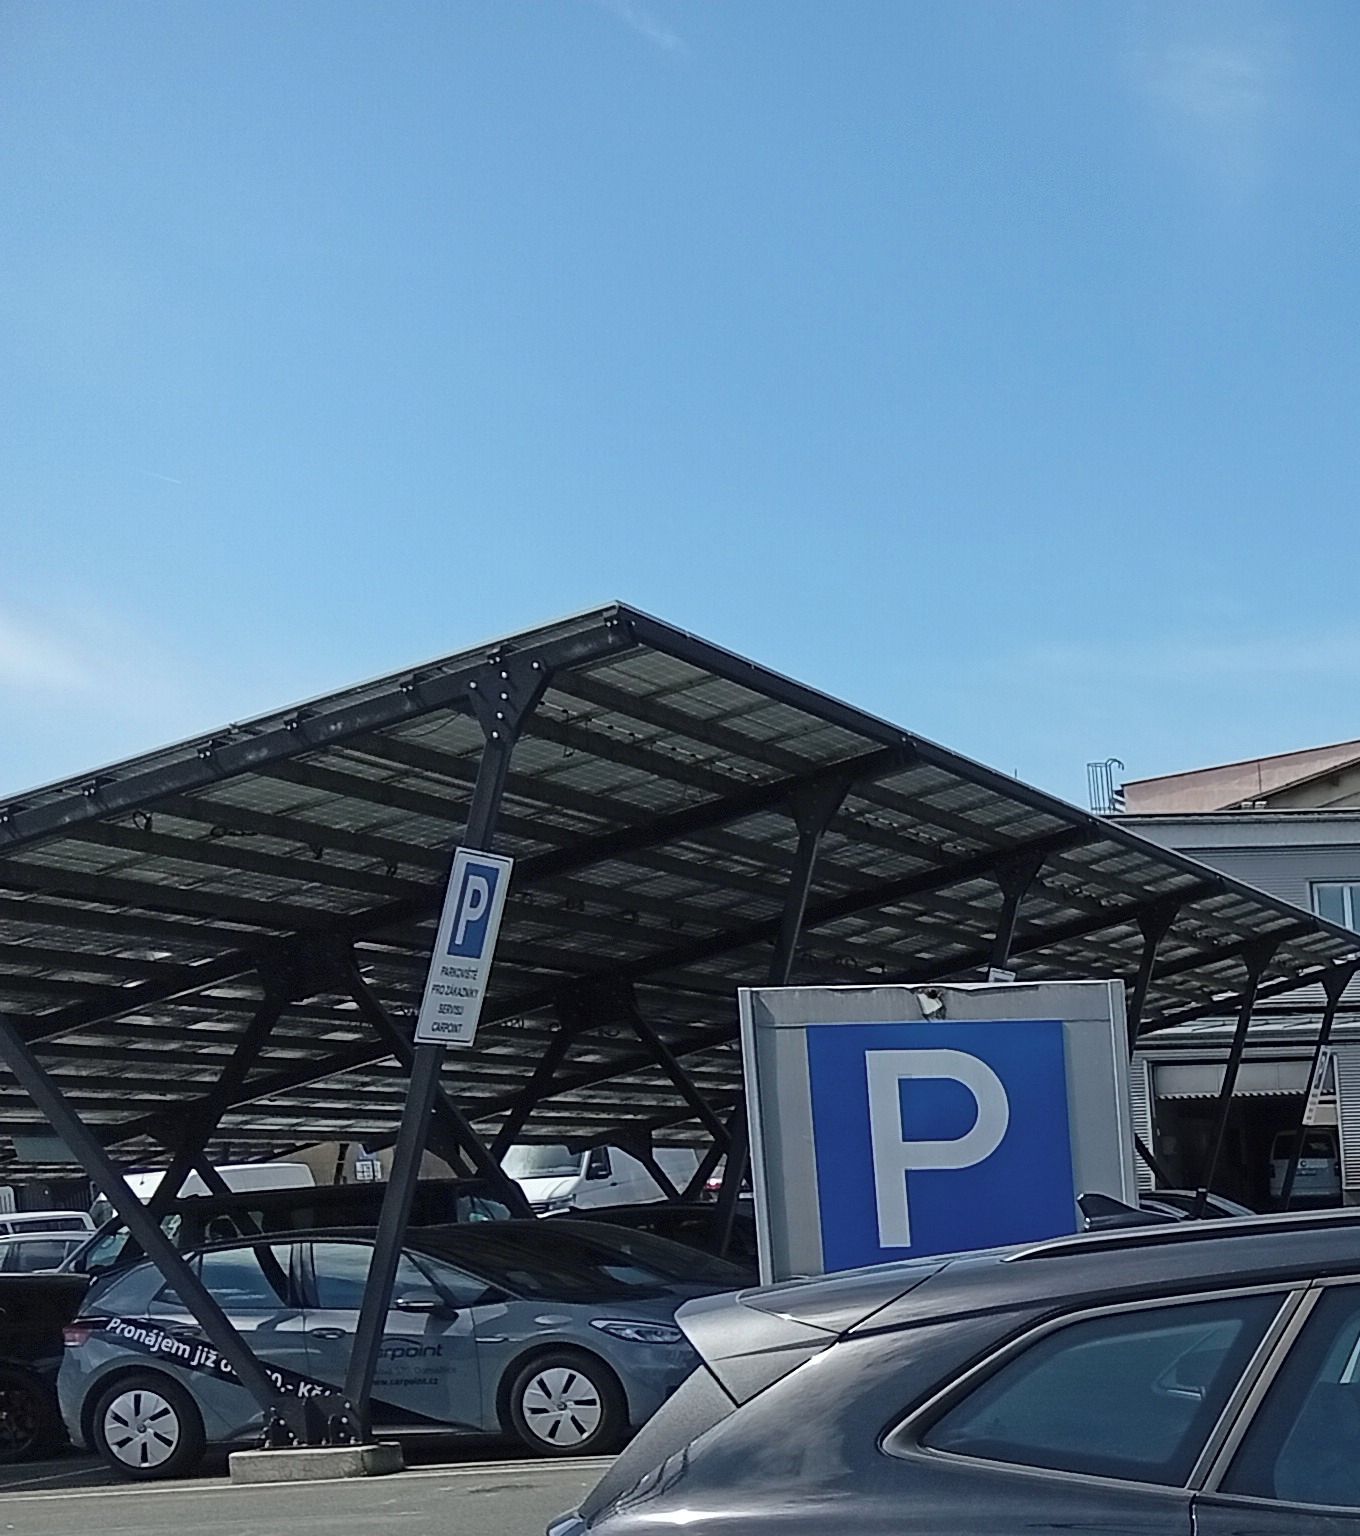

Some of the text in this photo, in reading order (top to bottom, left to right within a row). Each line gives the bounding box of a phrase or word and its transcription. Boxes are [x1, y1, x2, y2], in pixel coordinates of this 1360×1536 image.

[454, 874, 489, 945] P
[431, 984, 445, 996] PRO
[431, 1021, 463, 1034] CARPOINT
[865, 1048, 1010, 1248] P
[105, 1316, 190, 1359] Pronájem
[190, 1344, 218, 1368] již
